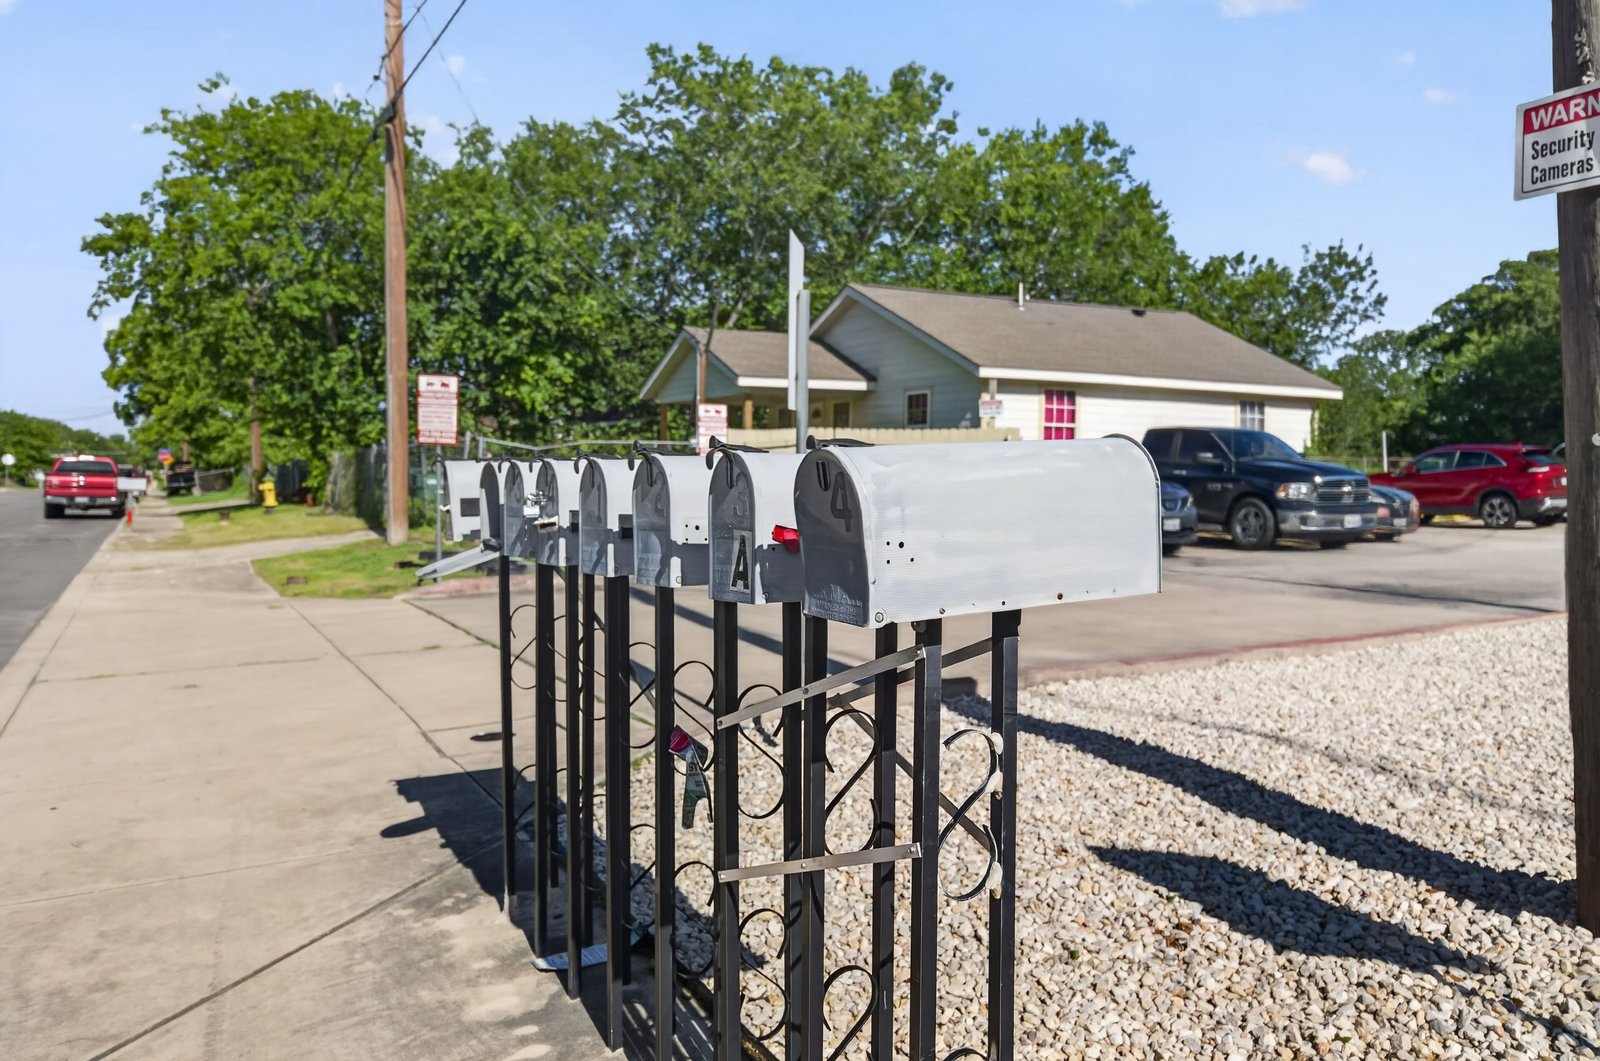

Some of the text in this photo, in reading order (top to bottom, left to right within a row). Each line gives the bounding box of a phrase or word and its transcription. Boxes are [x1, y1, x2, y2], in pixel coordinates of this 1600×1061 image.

[1531, 130, 1595, 161] Security
[1531, 157, 1594, 185] Cameras
[597, 483, 603, 523] 1
[655, 471, 666, 516] 2
[733, 471, 749, 524] 3
[830, 471, 853, 533] 4
[731, 534, 750, 590] A
